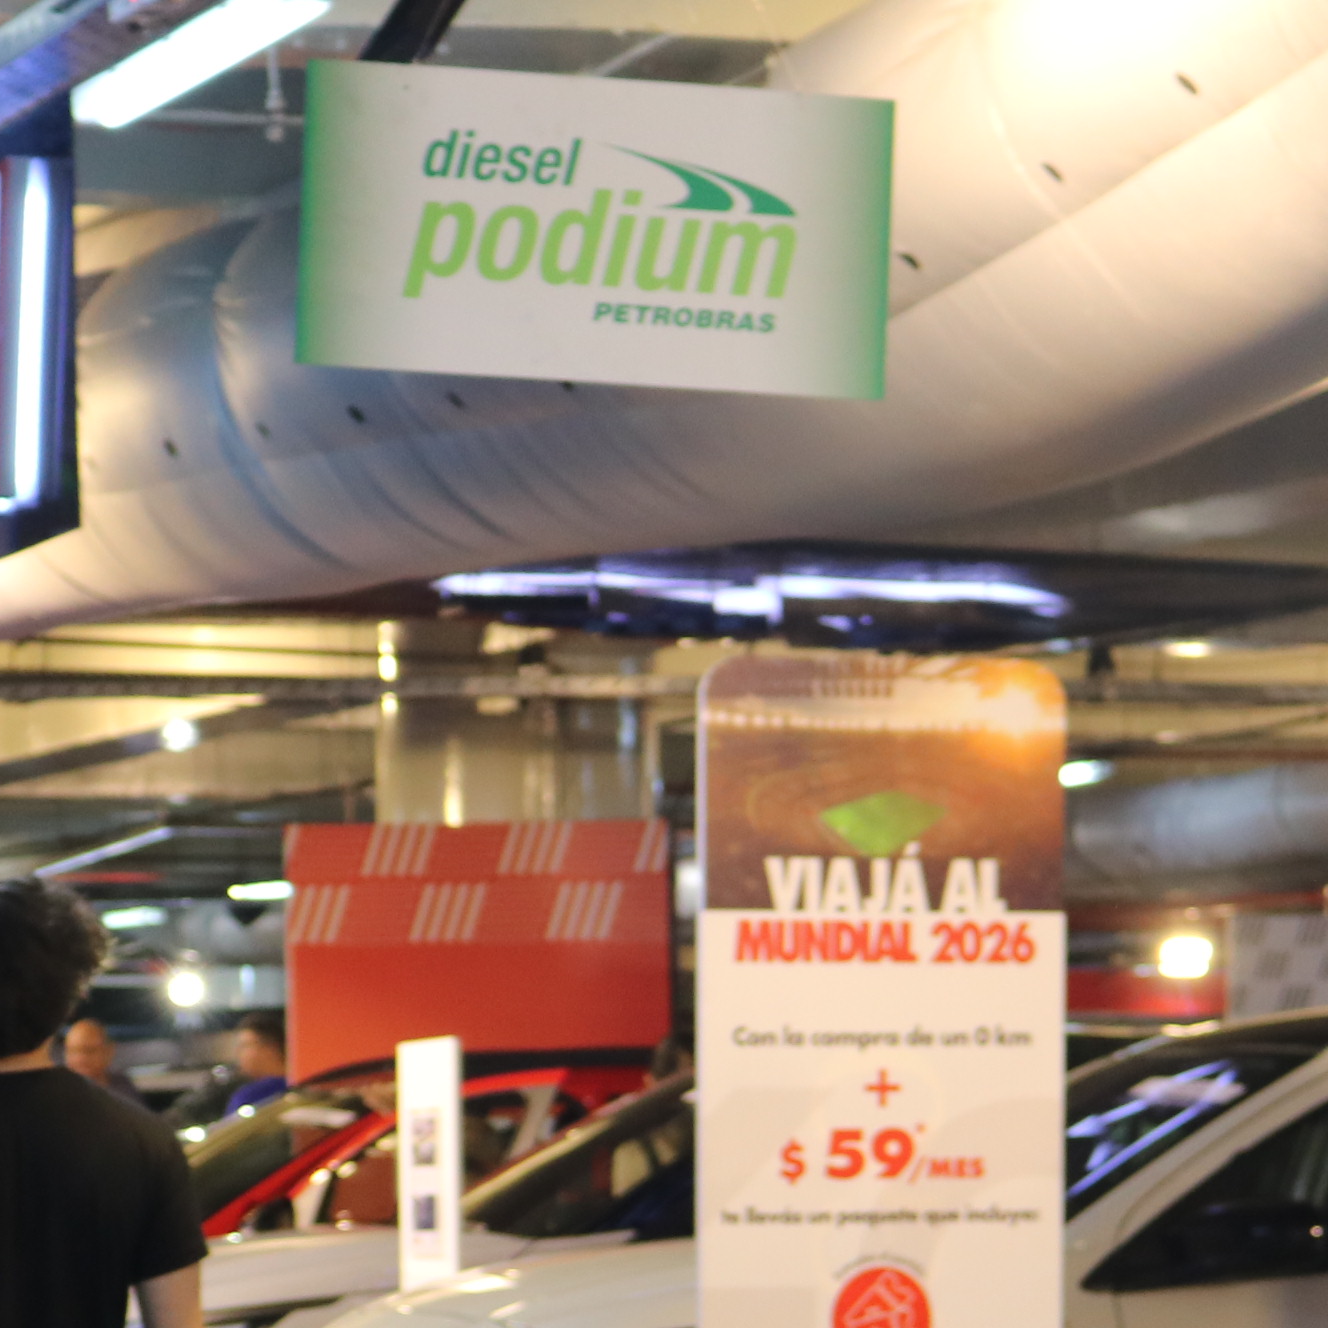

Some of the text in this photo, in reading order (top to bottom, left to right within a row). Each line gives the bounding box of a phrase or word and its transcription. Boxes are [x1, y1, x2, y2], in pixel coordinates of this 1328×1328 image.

[422, 129, 582, 187] diesel
[402, 188, 798, 299] podium
[591, 301, 777, 334] PETROBRAS
[763, 840, 1009, 913] VIAJÁ AL
[734, 919, 1038, 964] MUNDIAL 2026
[732, 1025, 778, 1047] Con
[782, 1024, 805, 1047] la
[811, 1029, 900, 1053] compra
[906, 1024, 934, 1047] de
[939, 1030, 969, 1047] un
[994, 1024, 1033, 1047] km
